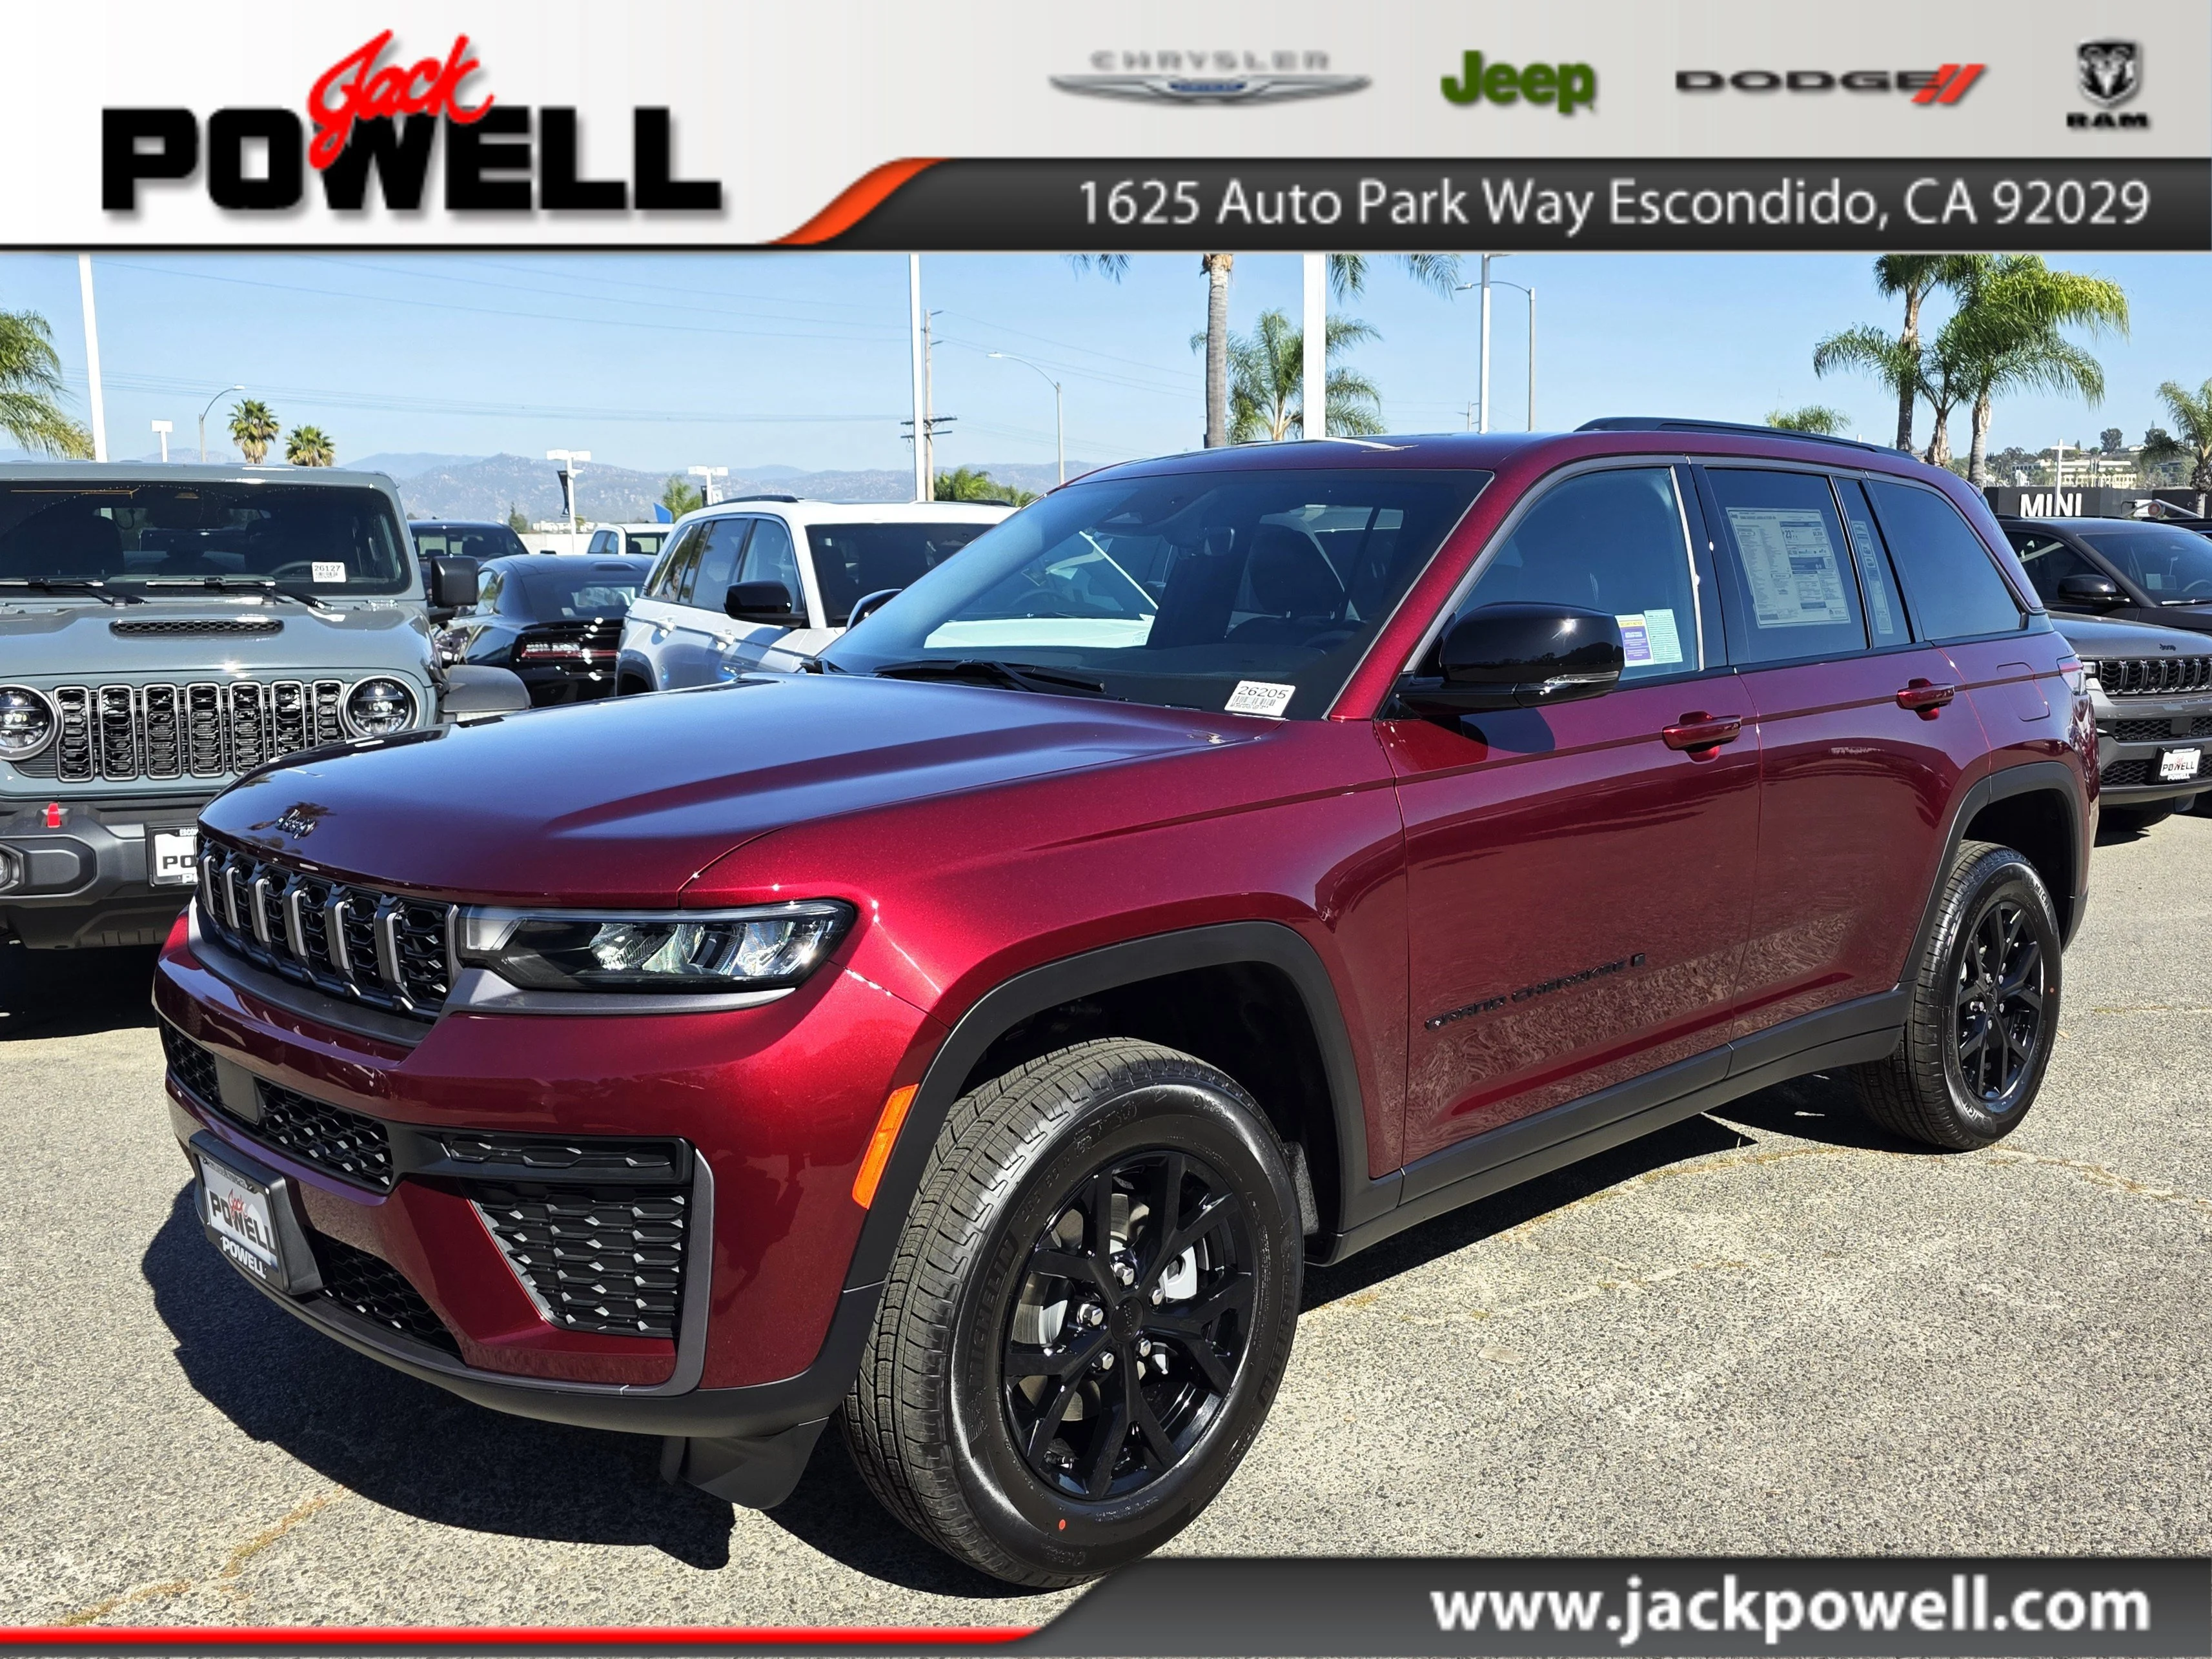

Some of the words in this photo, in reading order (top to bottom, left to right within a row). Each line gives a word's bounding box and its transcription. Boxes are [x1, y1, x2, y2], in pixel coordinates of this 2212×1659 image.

[2020, 493, 2082, 516] MINI
[1238, 686, 1289, 699] 26205
[2162, 762, 2195, 771] POWELL
[228, 1188, 248, 1221] Jack
[209, 1190, 276, 1255] POWELL
[221, 1235, 267, 1279] POWELL
